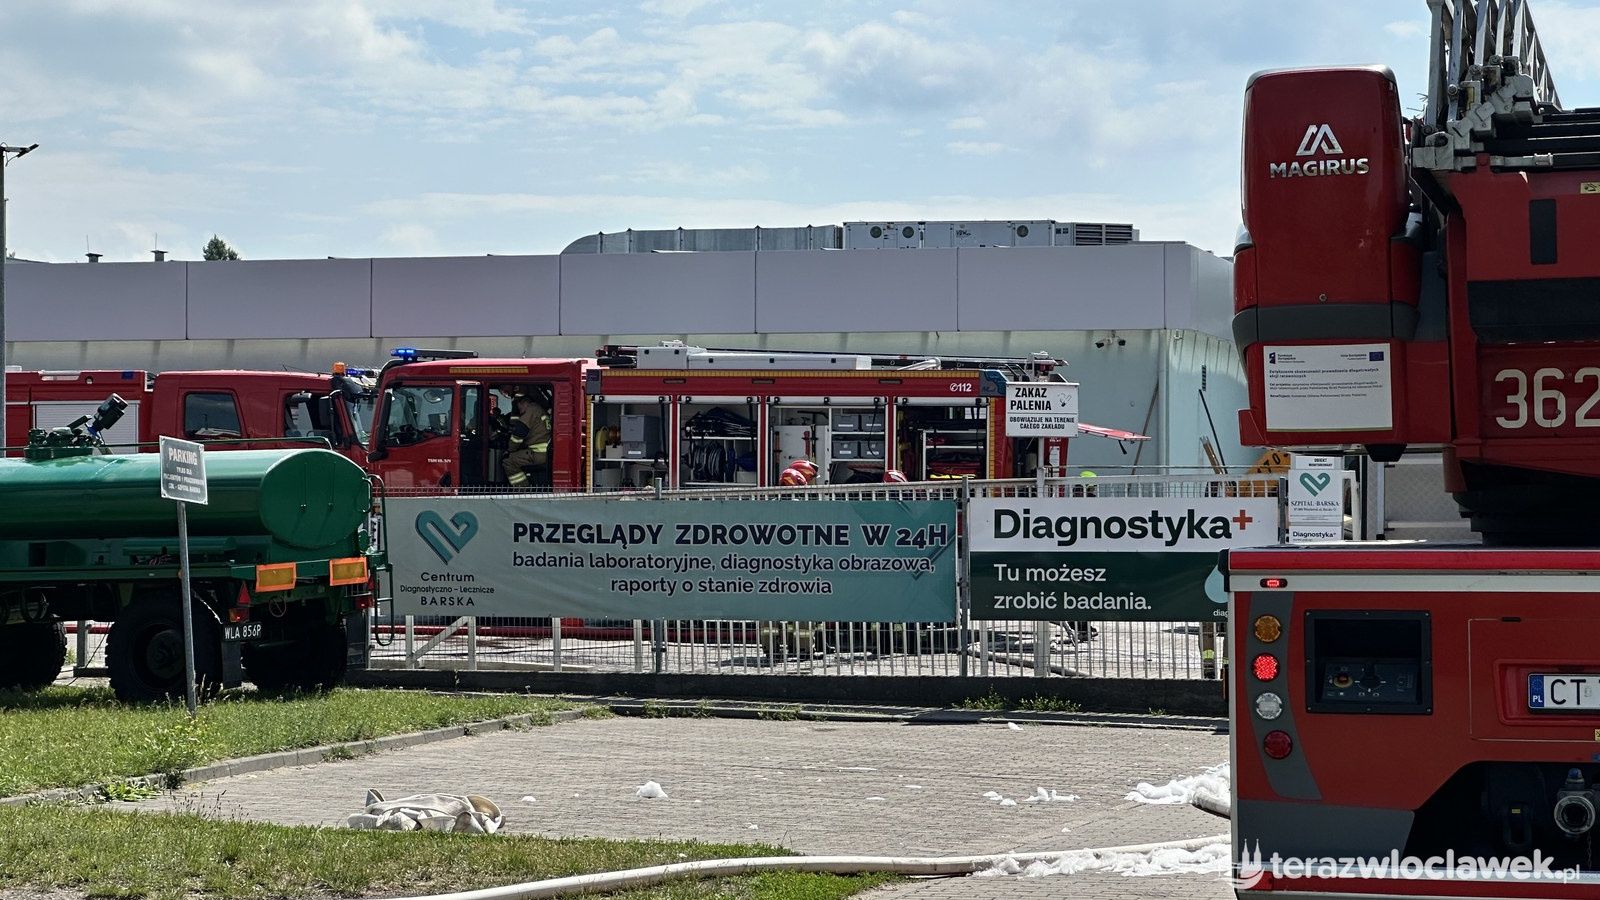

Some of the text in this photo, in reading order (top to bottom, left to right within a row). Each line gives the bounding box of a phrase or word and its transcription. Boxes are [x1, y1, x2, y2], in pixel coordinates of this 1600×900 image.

[1270, 158, 1369, 178] MAGIRUS
[957, 383, 972, 392] 112
[1015, 387, 1047, 398] ZAKAZ
[1010, 400, 1052, 410] PALENIA
[1495, 367, 1600, 428] 362
[168, 447, 198, 465] PARKING
[513, 522, 948, 550] PRZEGLĄDY ZDROWOTNE W 24H
[513, 552, 935, 574] badania laboratoryjne, diagnostyka obrazowa,
[421, 572, 475, 582] Centrum
[994, 563, 1107, 582] Tu możesz
[399, 585, 453, 594] Diagnostyczno
[460, 586, 495, 594] Lecznicze
[611, 577, 832, 596] raporty o stanie zdrowia
[421, 596, 475, 606] BARSKA
[994, 591, 1152, 610] zrobić badania.
[224, 624, 262, 639] WLA 856P
[1532, 695, 1543, 703] PL
[1551, 678, 1587, 706] CT
